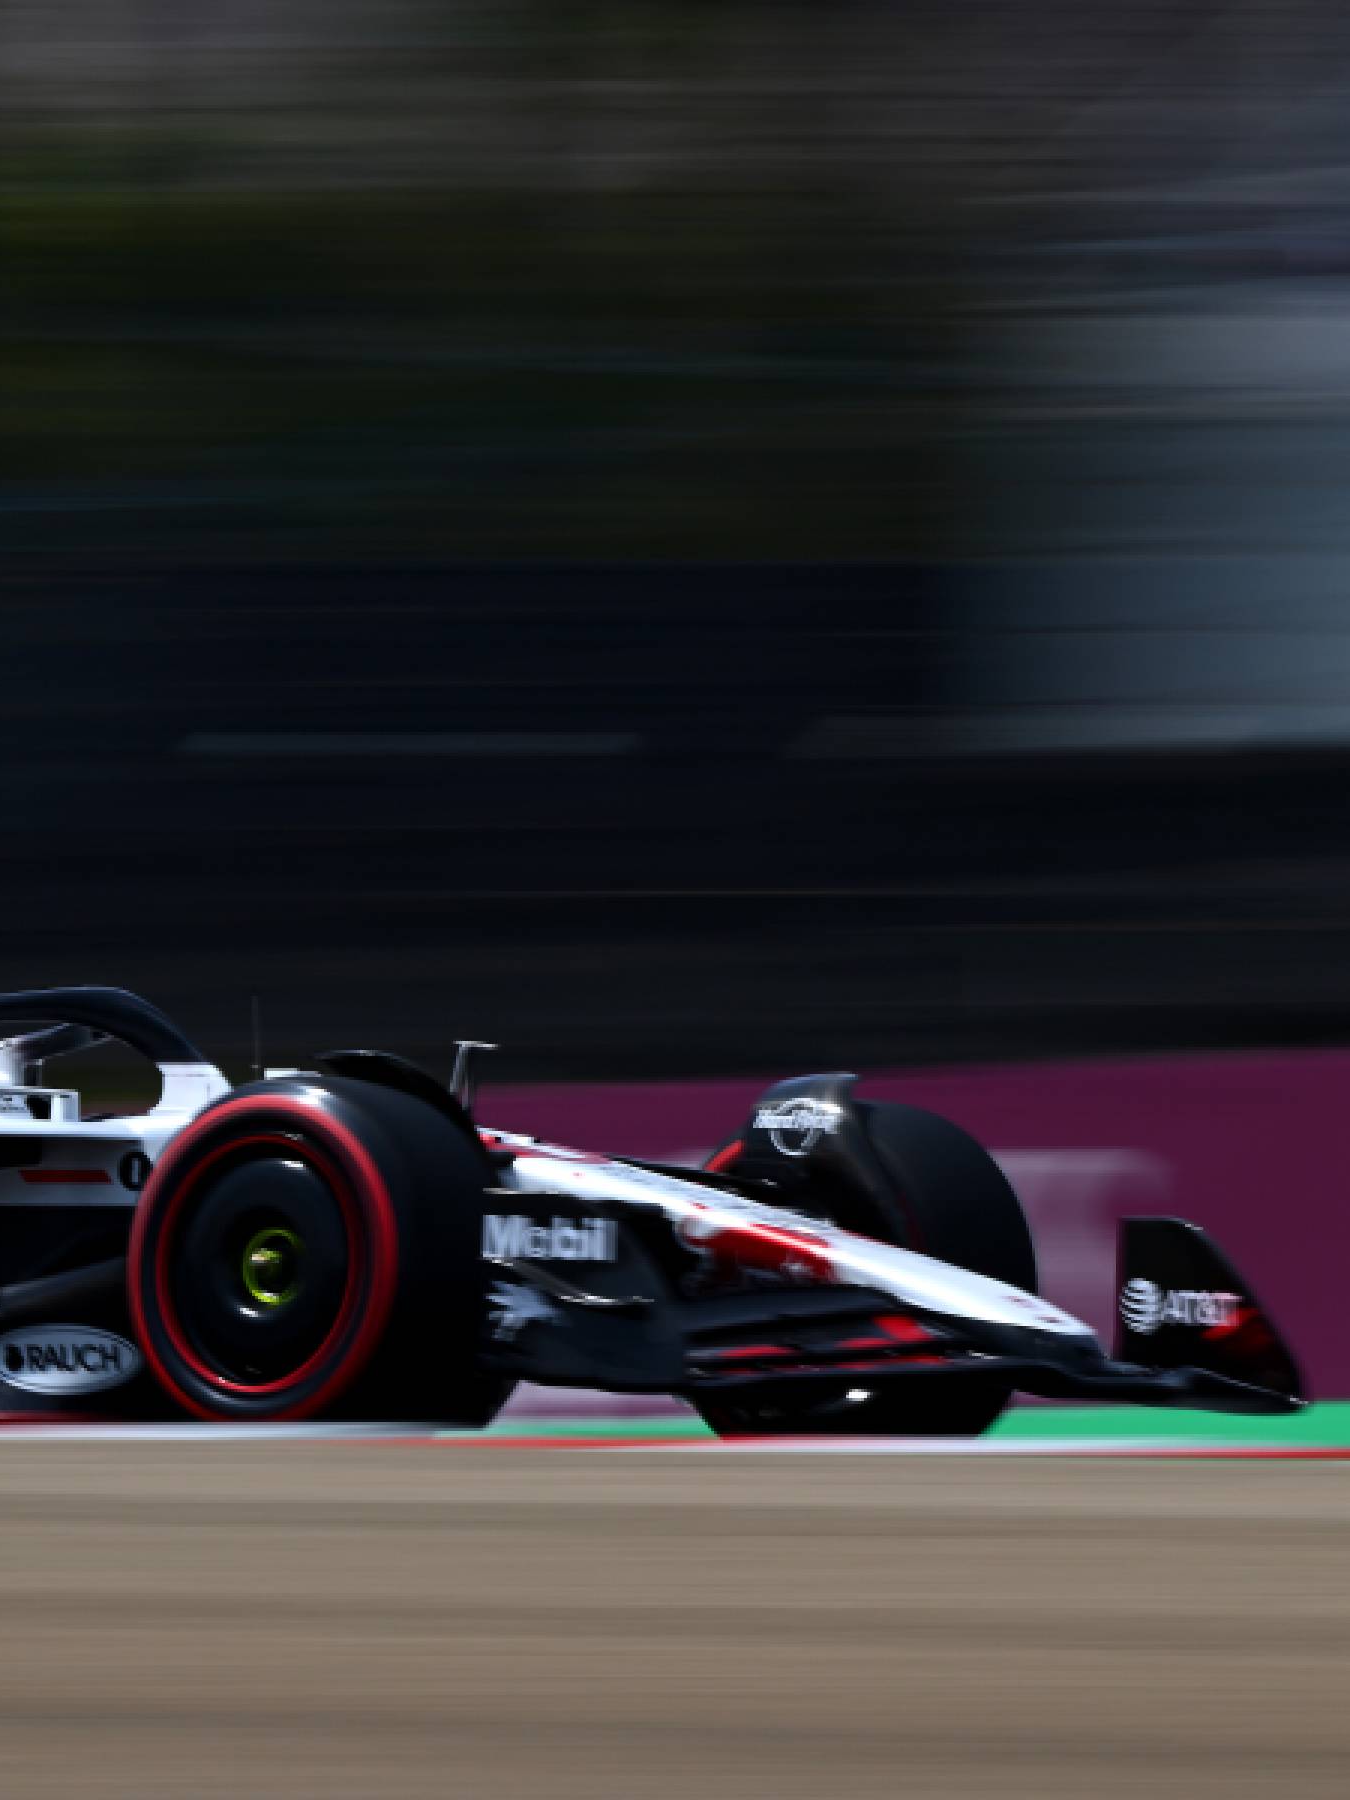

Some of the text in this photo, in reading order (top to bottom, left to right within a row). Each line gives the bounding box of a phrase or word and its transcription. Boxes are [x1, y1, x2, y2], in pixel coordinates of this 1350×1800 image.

[482, 1215, 618, 1261] Mobil
[1162, 1290, 1242, 1326] AT&T
[26, 1343, 121, 1372] RAUCH
